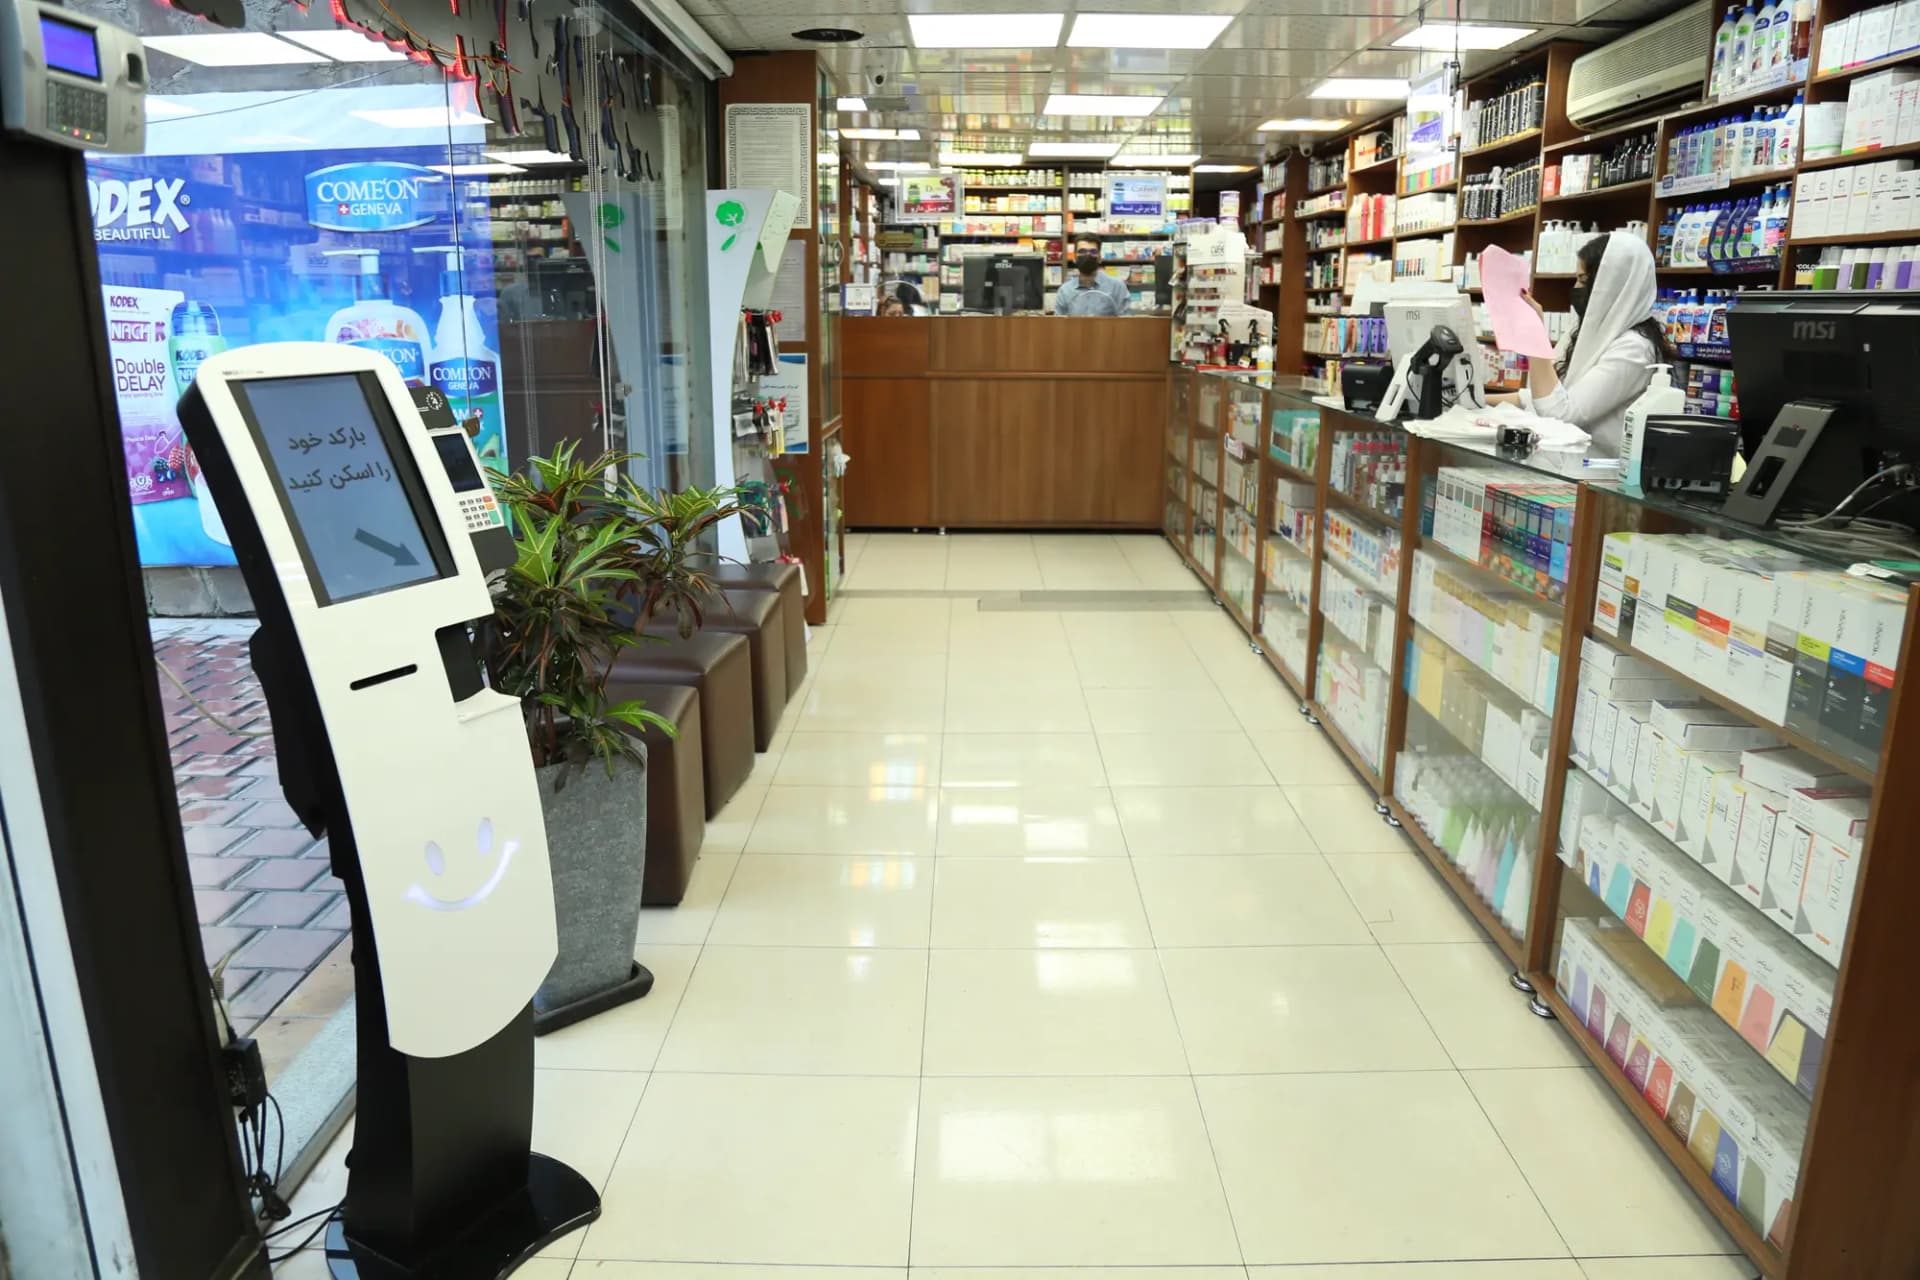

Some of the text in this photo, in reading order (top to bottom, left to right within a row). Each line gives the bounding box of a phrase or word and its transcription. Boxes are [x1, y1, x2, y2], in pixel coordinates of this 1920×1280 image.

[350, 203, 403, 216] GENEVA
[115, 357, 165, 375] Double
[117, 375, 166, 392] DELAY
[288, 427, 367, 455] بارکد خود
[289, 461, 392, 493] را اسکن کنید
